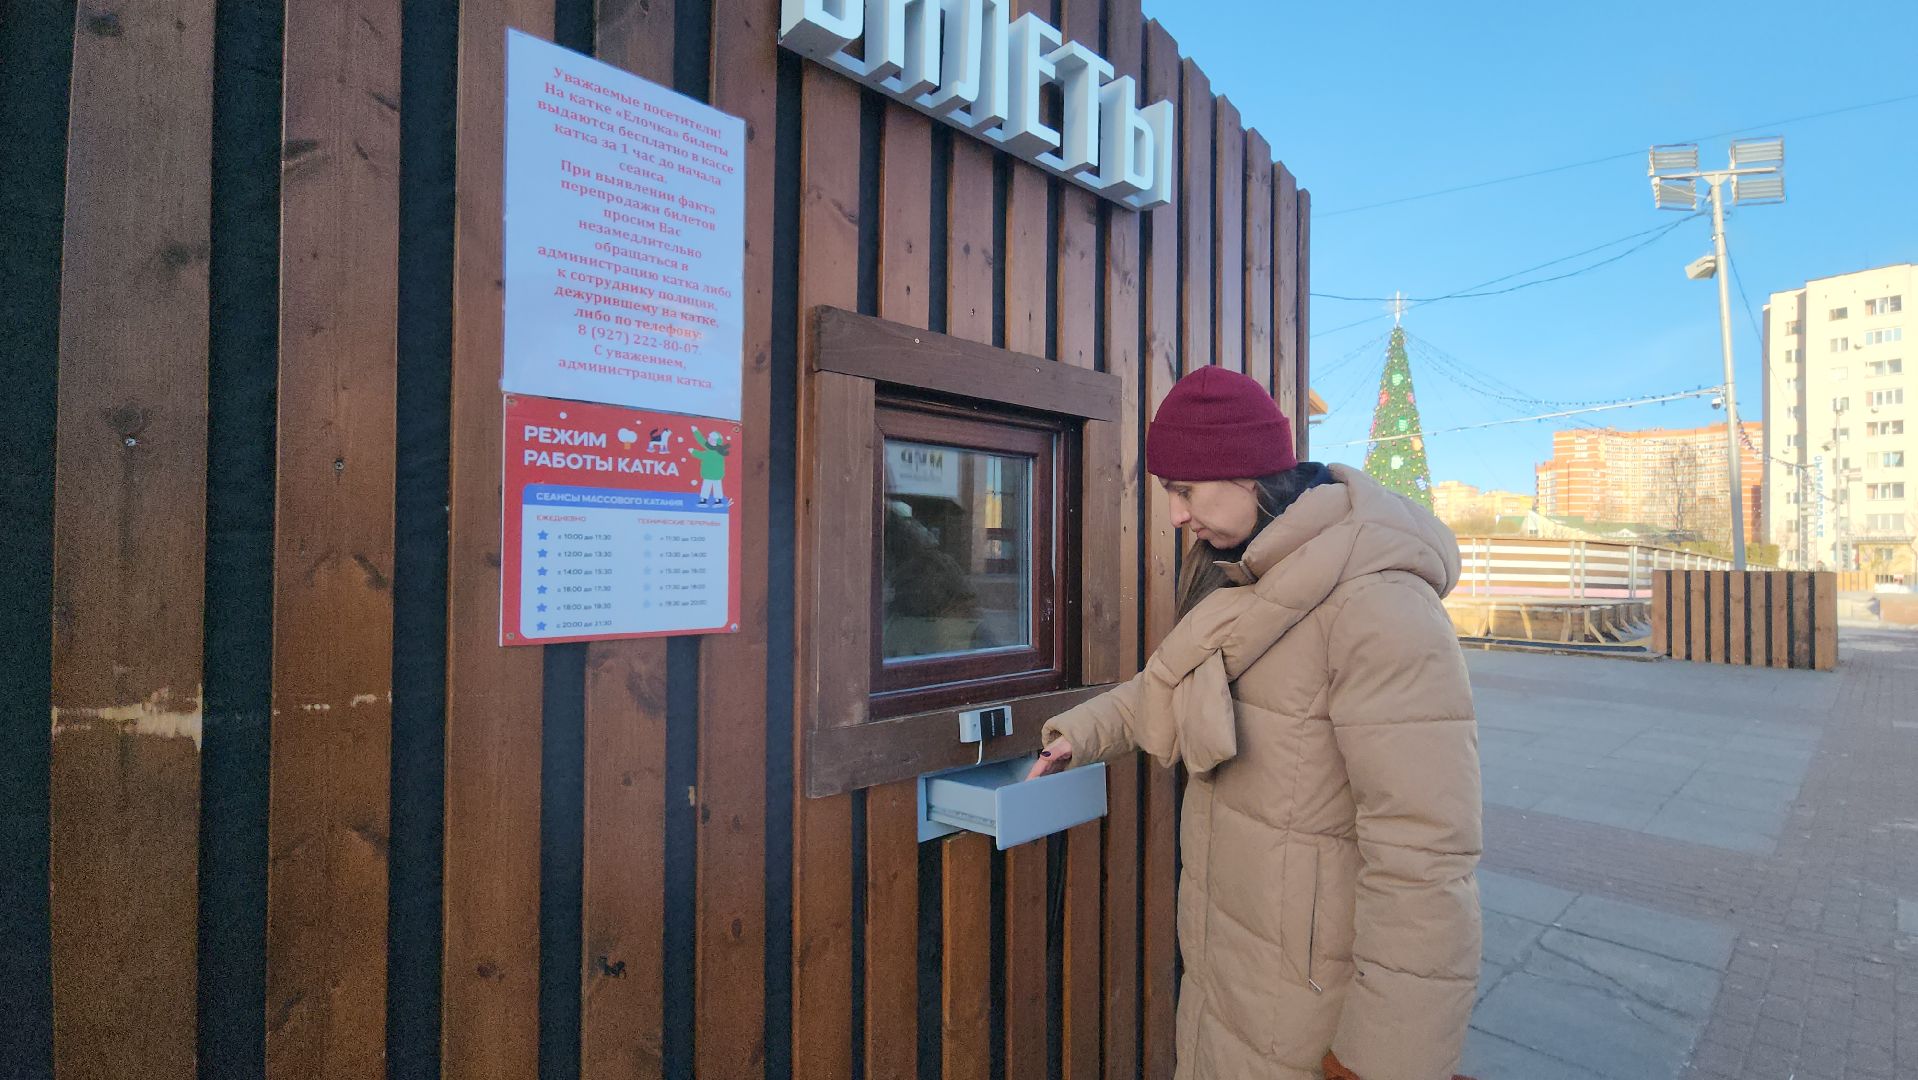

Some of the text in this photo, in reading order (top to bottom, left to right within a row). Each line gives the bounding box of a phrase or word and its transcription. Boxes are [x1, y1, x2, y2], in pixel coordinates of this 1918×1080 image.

[554, 67, 721, 139] Уважаемые посетители!
[545, 82, 564, 98] На
[569, 93, 612, 114] катке
[682, 132, 728, 157] билеты
[538, 100, 735, 174] выдаются бесплатно в кассе
[554, 124, 721, 186] катка за 1 час до начала
[561, 160, 716, 215] При выявлении факта
[561, 180, 716, 231] перепродажи билетов
[604, 210, 681, 236] просим Вас
[579, 220, 702, 258] незамедлительно
[595, 242, 689, 271] обращаться в
[538, 246, 732, 298] администрацию катка либо
[557, 268, 566, 278] к
[570, 272, 654, 299] сотруднику
[574, 308, 611, 322] либо
[615, 315, 632, 326] по
[662, 308, 677, 317] на
[578, 324, 586, 336] 8
[591, 327, 629, 345] (927)
[594, 344, 602, 356] С
[558, 359, 712, 389] администрация катка
[524, 425, 607, 448] РЕЖИМ
[524, 450, 679, 477] РАБОТЫ КАТКА
[536, 492, 581, 503] СЕАНСЫ
[581, 494, 643, 505] МАССОВОГО
